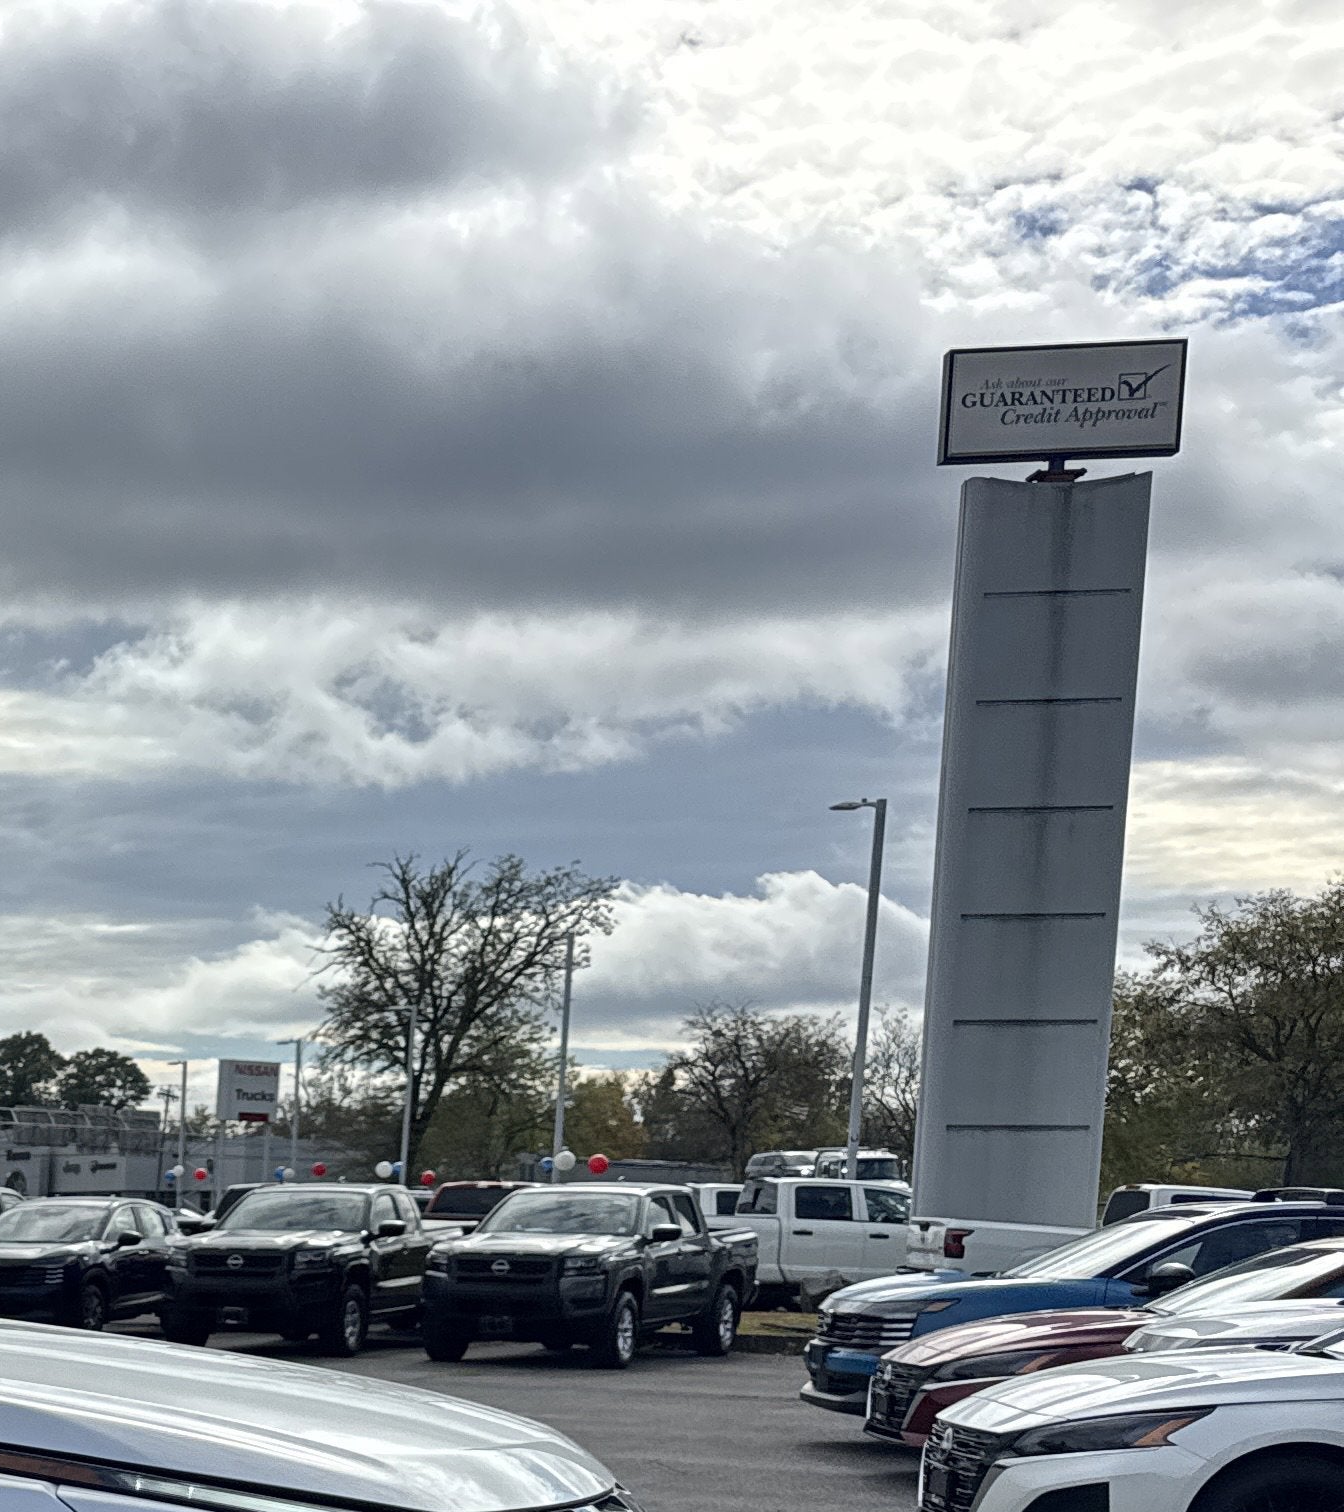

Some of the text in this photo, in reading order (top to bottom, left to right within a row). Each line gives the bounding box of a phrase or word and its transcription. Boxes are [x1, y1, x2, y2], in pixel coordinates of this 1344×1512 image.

[981, 377, 1069, 390] Ask about our
[962, 387, 1115, 408] GUARANTEED
[1000, 402, 1158, 428] Credit Approval
[235, 1064, 279, 1077] NISSAN
[236, 1088, 276, 1102] Trucks
